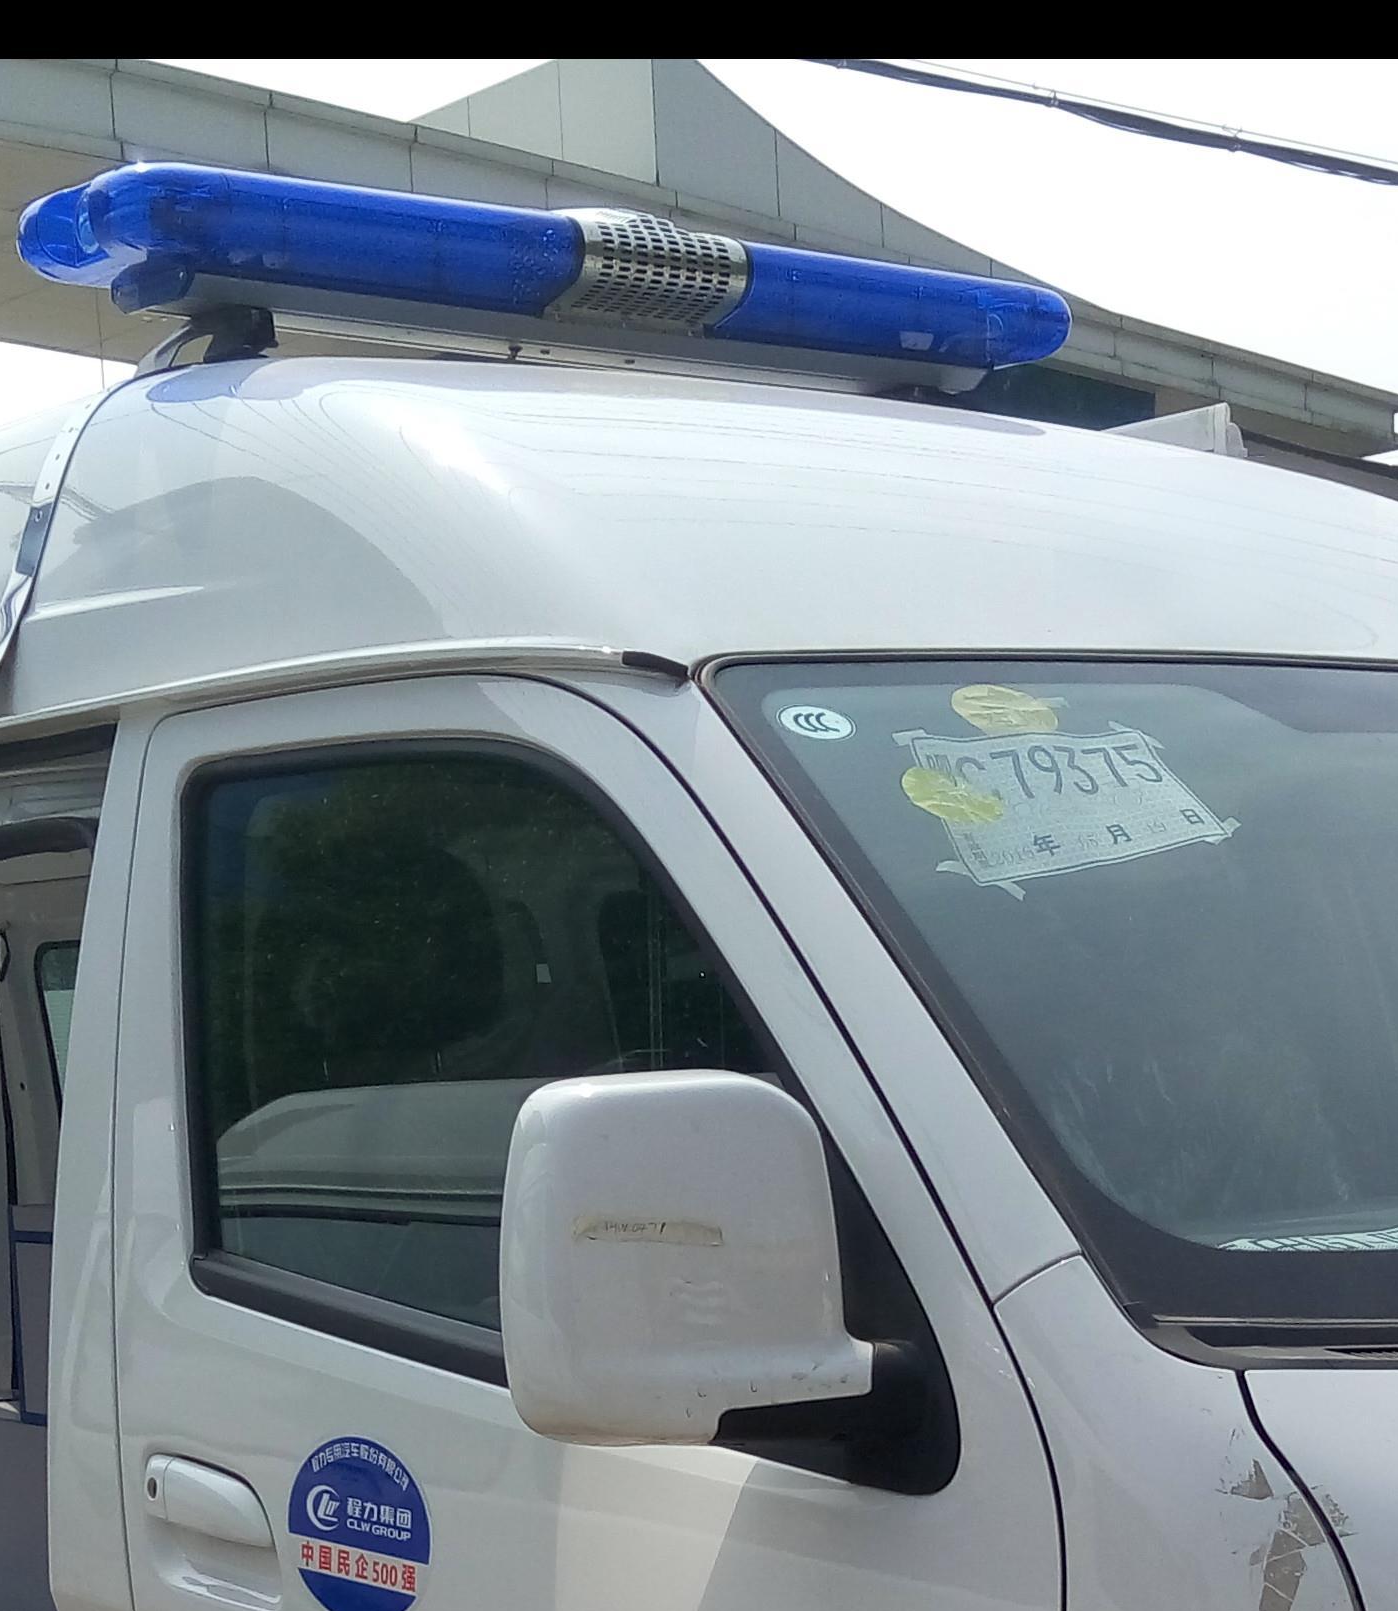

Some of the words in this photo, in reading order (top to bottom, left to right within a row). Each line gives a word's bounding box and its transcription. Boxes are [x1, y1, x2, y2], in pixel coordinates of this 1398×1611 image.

[1106, 823, 1132, 845] 月
[1180, 808, 1205, 825] 日
[347, 1497, 412, 1529] 程力集团
[346, 1518, 371, 1532] CLW
[371, 1525, 411, 1541] GROUP
